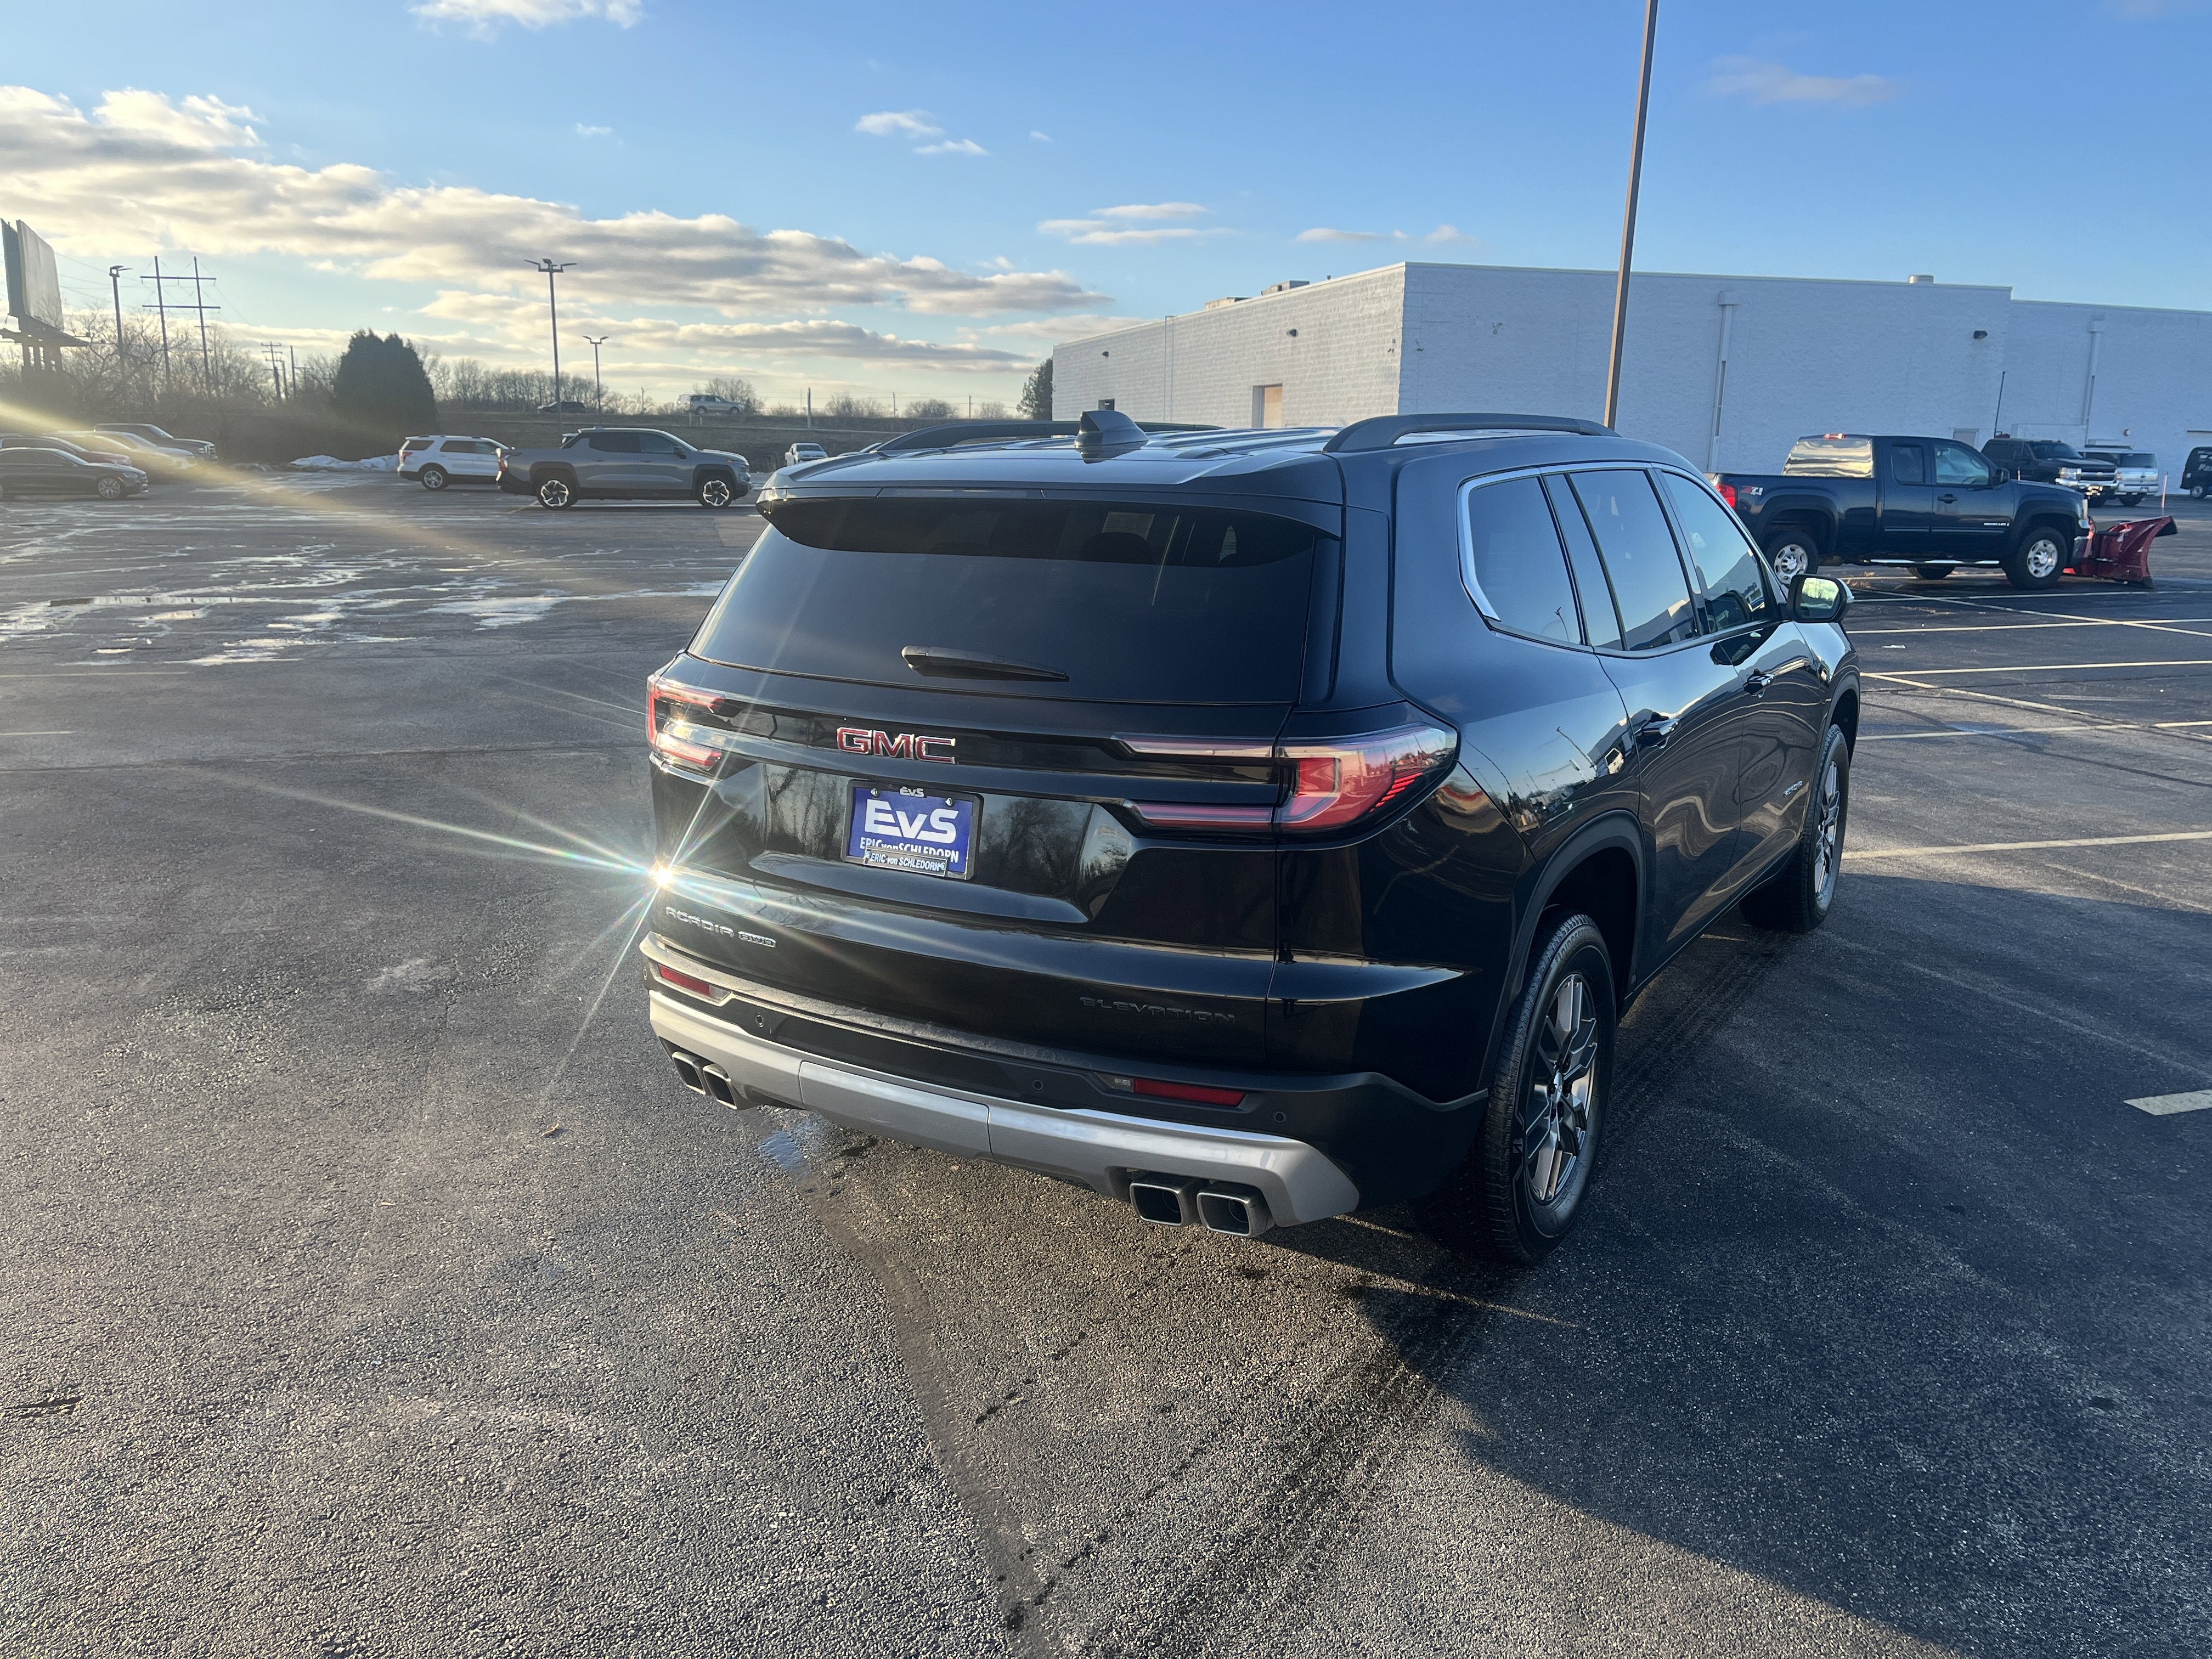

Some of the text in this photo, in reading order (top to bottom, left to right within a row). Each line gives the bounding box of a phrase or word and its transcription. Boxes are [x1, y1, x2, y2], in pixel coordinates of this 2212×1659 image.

[837, 727, 956, 764] GMC
[865, 799, 958, 843] EvS
[871, 853, 885, 862] ERIC
[899, 856, 939, 871] SCHLEDORN
[666, 907, 776, 947] ACADIA AWD
[1080, 997, 1234, 1022] ELEVATION
